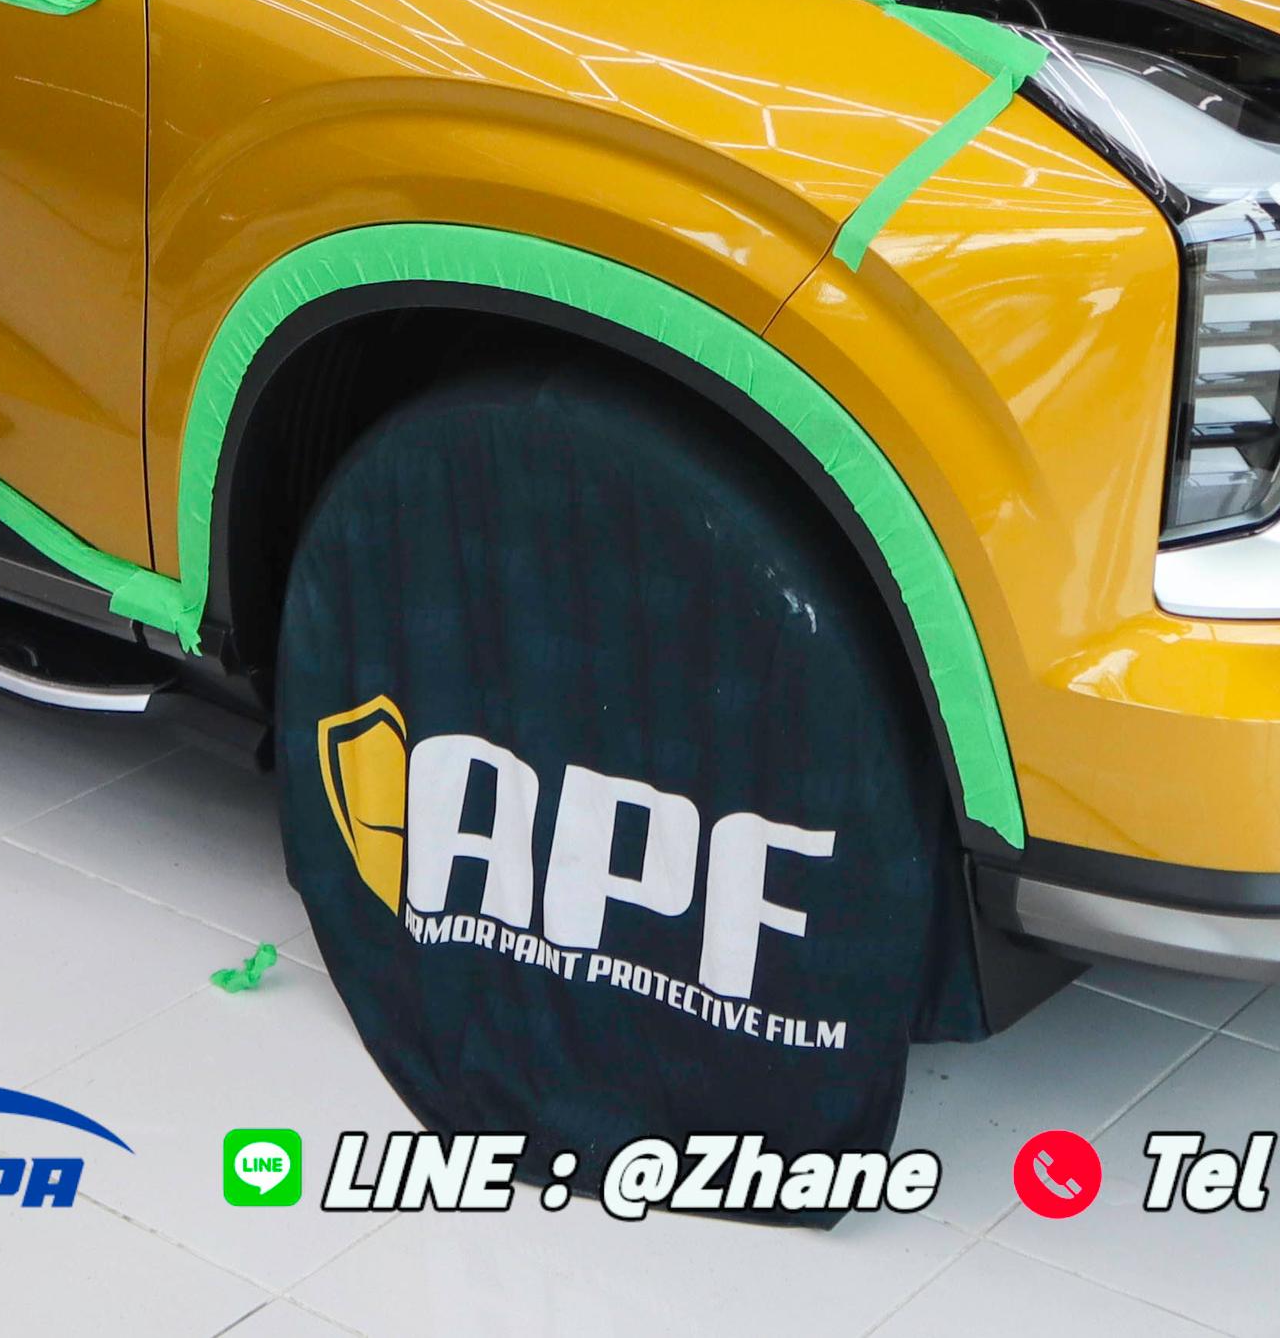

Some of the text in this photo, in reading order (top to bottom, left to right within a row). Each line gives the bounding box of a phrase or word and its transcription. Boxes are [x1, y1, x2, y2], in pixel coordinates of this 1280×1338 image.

[406, 733, 837, 999] APF
[404, 903, 847, 1049] ARMOR PAINT PROTECTIVE FILM
